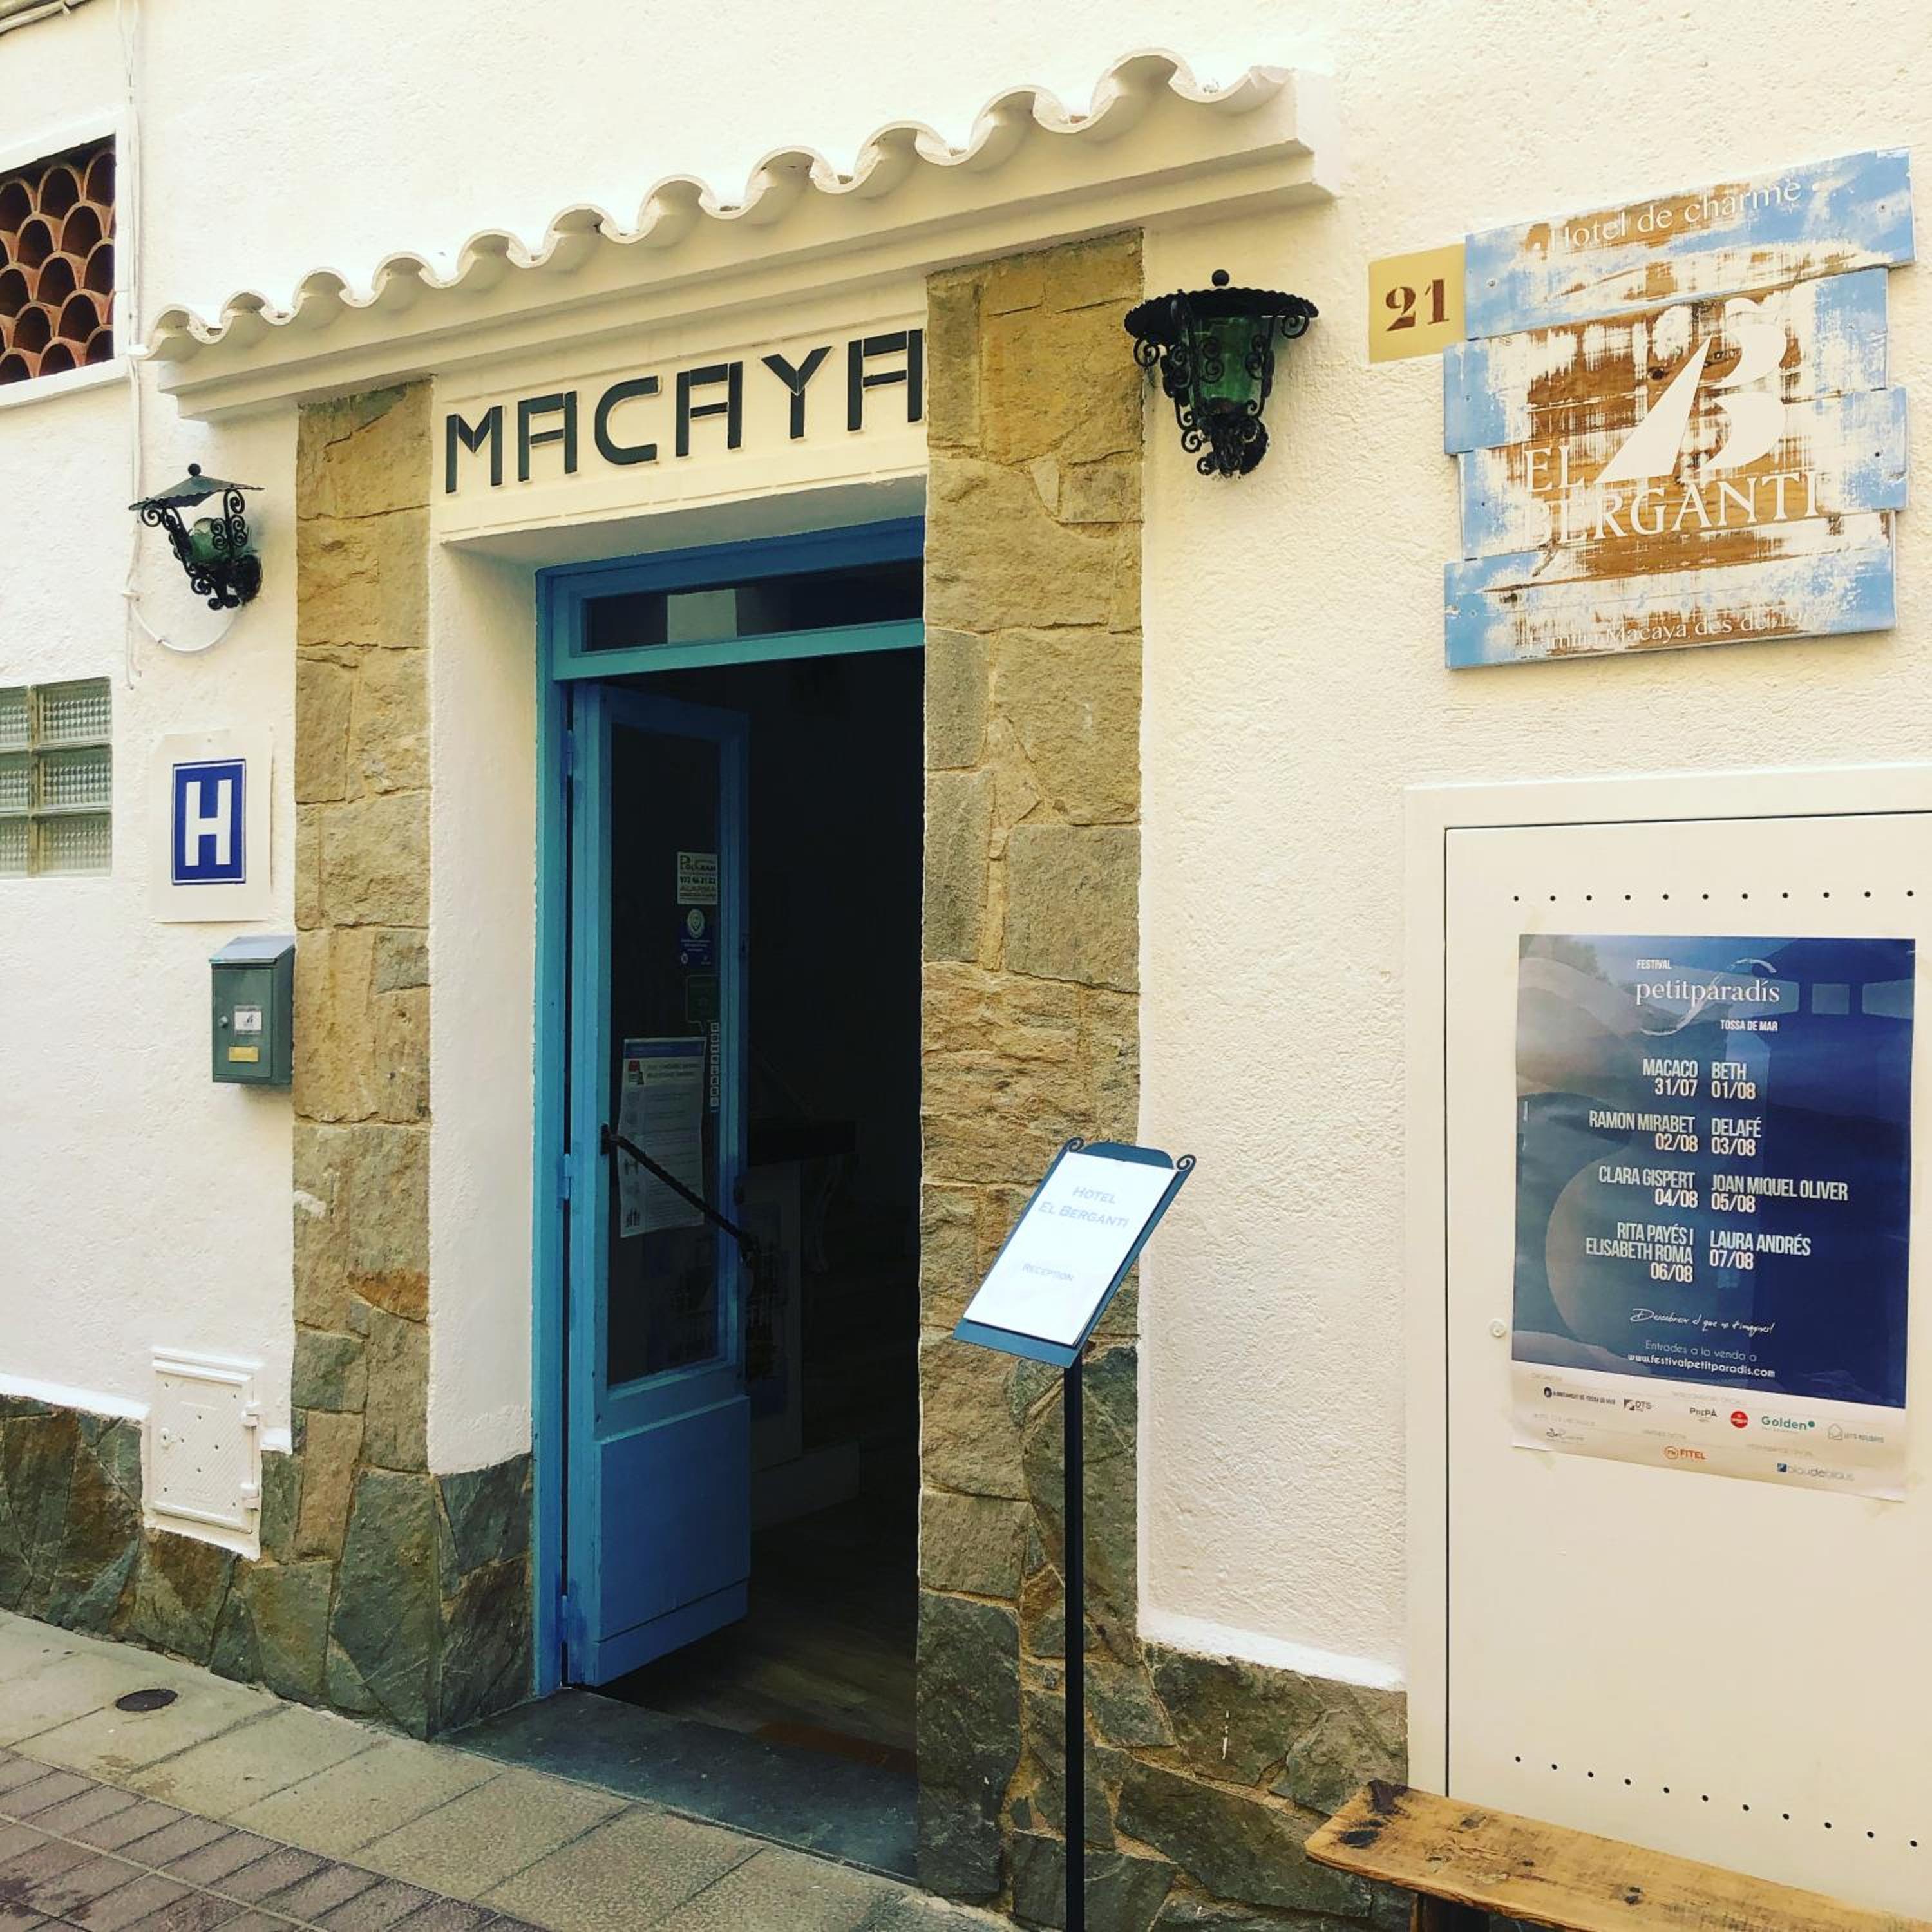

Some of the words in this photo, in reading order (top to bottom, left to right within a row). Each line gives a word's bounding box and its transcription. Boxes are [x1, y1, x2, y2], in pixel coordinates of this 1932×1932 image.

[1551, 211, 1627, 251] Hotel
[1638, 206, 1674, 234] de
[1385, 279, 1450, 332] 21
[446, 329, 925, 494] MACAYA
[1524, 445, 1586, 493] EL
[185, 779, 232, 866] H
[1636, 959, 1672, 970] FESTIVAL
[1636, 980, 1780, 1007] petitparadís
[1721, 1019, 1745, 1030] TOSSA
[1747, 1021, 1758, 1030] DE
[1759, 1021, 1778, 1031] MAR
[1643, 1058, 1698, 1077] MACACO
[1711, 1062, 1747, 1081] BETH
[1654, 1078, 1698, 1097] 31/07
[1711, 1081, 1756, 1100] 01/08
[1589, 1110, 1635, 1130] RAMON
[1638, 1113, 1695, 1133] MIRABET
[1711, 1117, 1762, 1138] DELAFÉ
[1655, 1133, 1698, 1152] 02/08
[1711, 1137, 1756, 1157] 03/08
[1599, 1166, 1640, 1185] CLARA
[1643, 1169, 1695, 1189] GISPERT
[1711, 1174, 1745, 1193] JOAN
[1747, 1177, 1797, 1198] MIQUEL
[1800, 1180, 1848, 1201] OLIVER
[1072, 1186, 1115, 1204] HOTEL
[1654, 1188, 1698, 1208] 04/08
[1711, 1193, 1756, 1213] 05/08
[1038, 1201, 1056, 1215] EL
[1059, 1205, 1130, 1227] BERGANTI
[1617, 1222, 1645, 1241] RITA
[1647, 1224, 1687, 1245] PAYÉS
[1689, 1227, 1694, 1245] I
[1710, 1229, 1754, 1251] LAURA
[1756, 1233, 1812, 1256] ANDRÉS
[1586, 1237, 1653, 1261] ELISABETH
[1654, 1244, 1694, 1264] ROMA
[1710, 1249, 1754, 1271] 07/08
[1650, 1262, 1694, 1283] 06/08
[1645, 1339, 1687, 1354] Entrades
[1690, 1347, 1698, 1356] a
[1701, 1346, 1711, 1357] la
[1714, 1349, 1746, 1361] venda
[1750, 1354, 1757, 1363] a
[1627, 1353, 1776, 1378] www.festivalpetitparadis.com
[1761, 1415, 1807, 1430] Golden
[1680, 1448, 1706, 1460] FITEL
